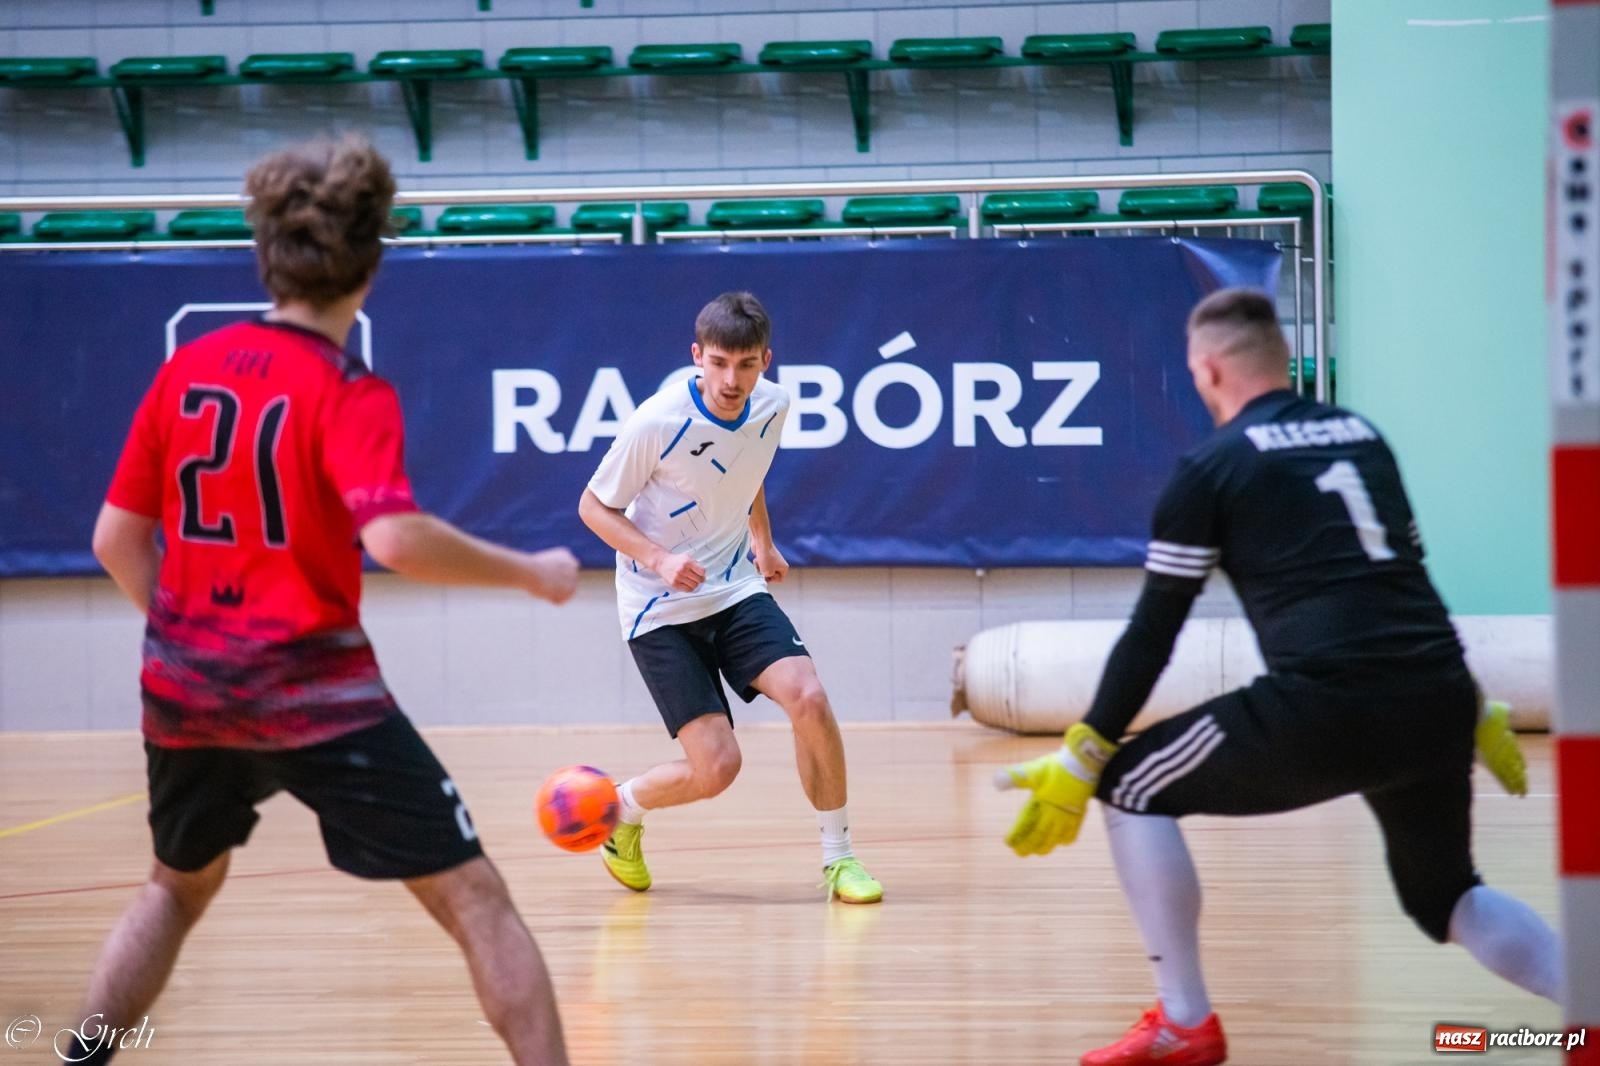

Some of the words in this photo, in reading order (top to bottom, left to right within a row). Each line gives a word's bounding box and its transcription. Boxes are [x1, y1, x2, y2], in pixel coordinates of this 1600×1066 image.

[491, 331, 1104, 454] RABÓRZ
[176, 382, 291, 549] 21
[1313, 459, 1398, 562] 1
